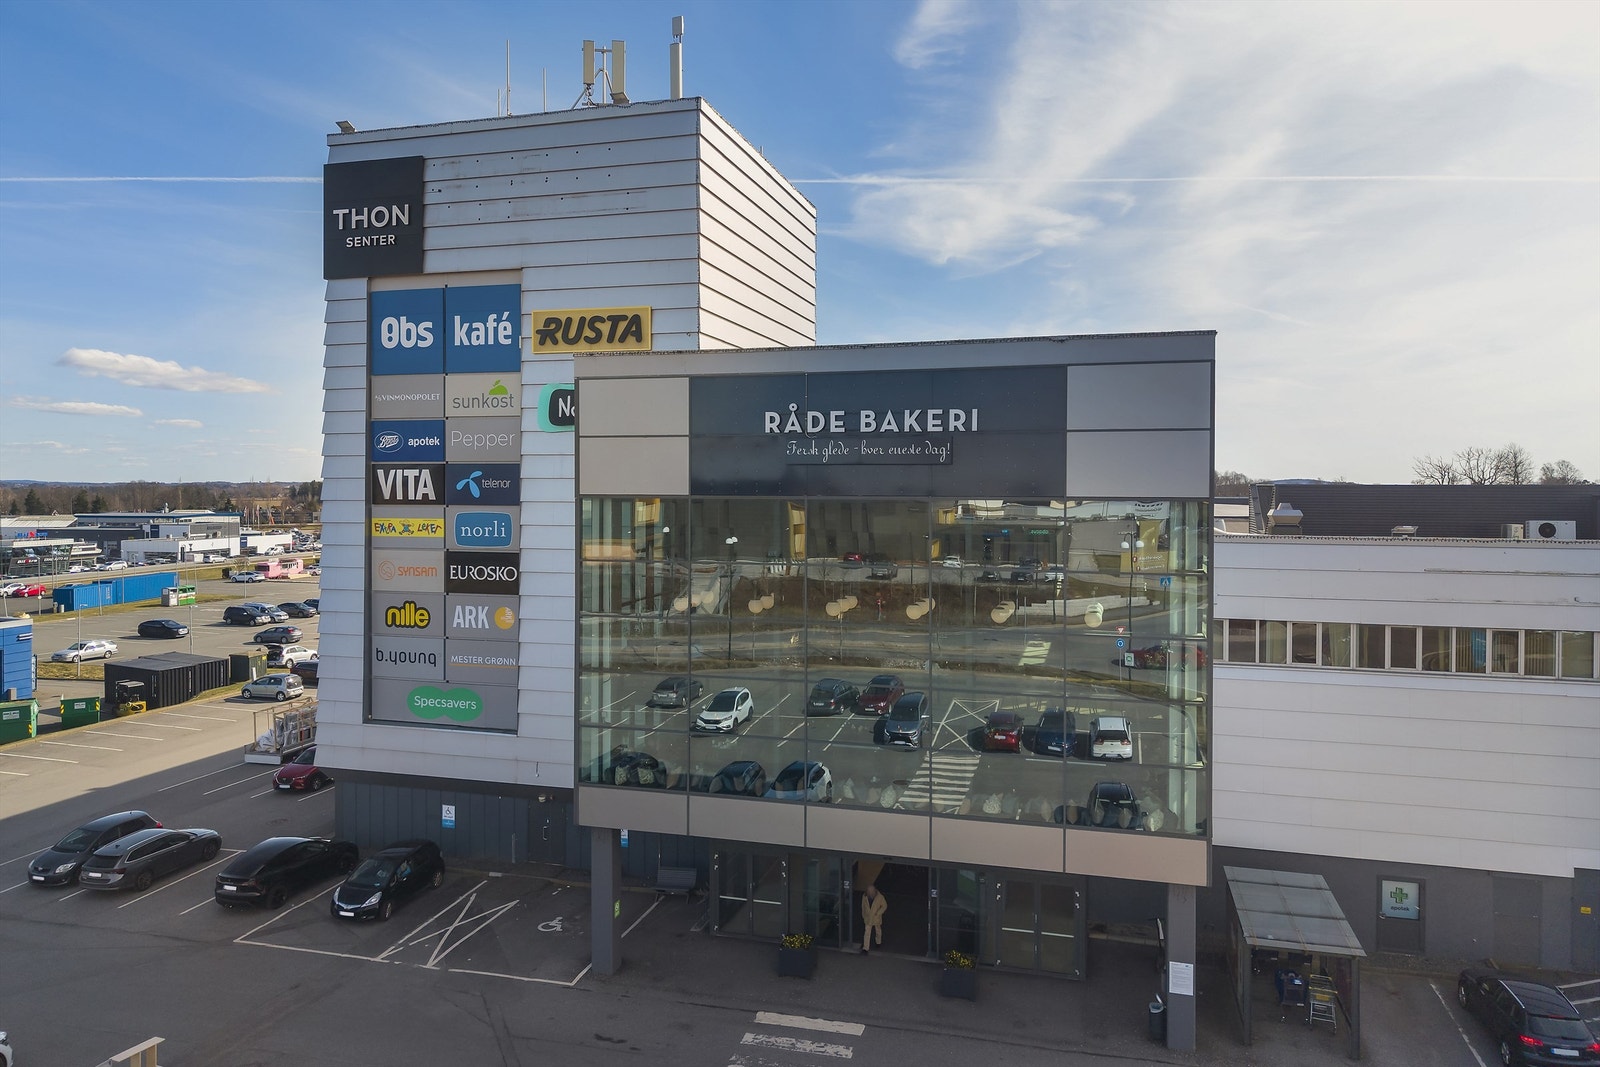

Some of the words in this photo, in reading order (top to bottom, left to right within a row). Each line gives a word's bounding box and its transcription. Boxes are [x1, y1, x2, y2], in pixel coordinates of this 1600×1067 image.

[333, 204, 410, 230] THON
[346, 234, 396, 248] SENTER
[380, 316, 434, 349] Obs
[454, 311, 512, 346] kafé
[536, 313, 643, 346] RUSTA
[381, 393, 440, 401] VINMONOPOLET
[452, 393, 514, 409] sunkost
[765, 402, 846, 434] RÅDE
[860, 408, 979, 433] BAKERI
[408, 436, 440, 447] apotek
[451, 430, 516, 450] Pepper
[787, 440, 818, 456] Fersk
[822, 440, 849, 463] glede
[888, 442, 921, 455] eneste
[925, 441, 950, 463] dag!
[377, 469, 436, 501] VITA
[482, 478, 511, 489] telenor
[460, 521, 506, 538] norli
[397, 566, 438, 577] SYNSAM
[450, 565, 518, 581] EUROSKO
[386, 601, 430, 628] nille
[453, 605, 490, 629] ARK
[376, 647, 437, 667] b.young
[450, 655, 483, 664] MESTER
[485, 656, 516, 666] GRØNN
[414, 695, 477, 710] Specsavers
